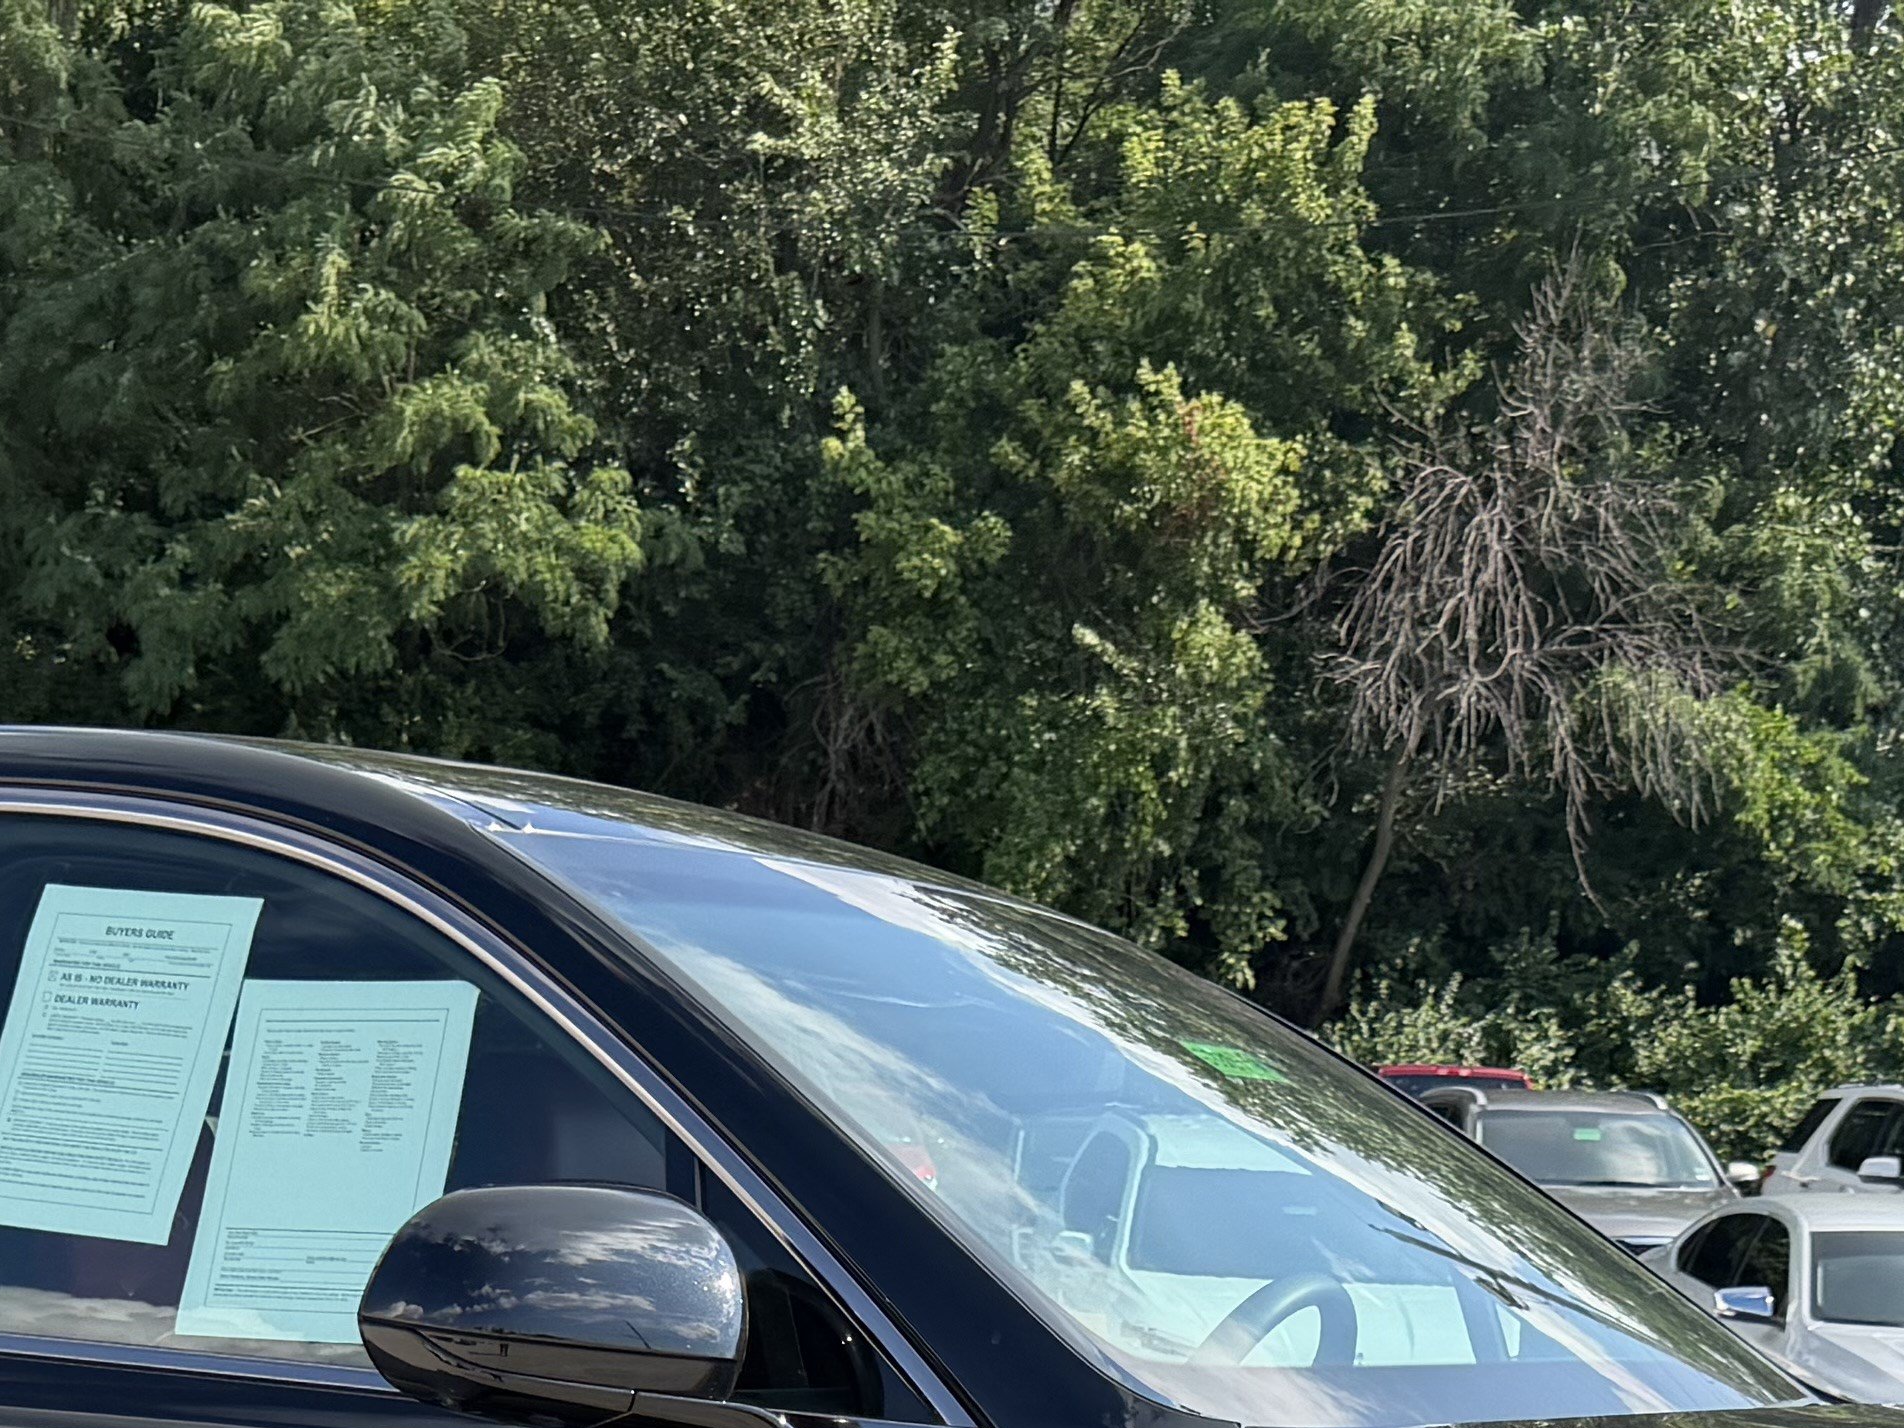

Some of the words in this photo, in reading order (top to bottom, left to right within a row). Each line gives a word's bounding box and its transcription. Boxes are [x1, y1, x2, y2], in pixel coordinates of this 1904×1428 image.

[105, 926, 144, 938] BUYERS
[145, 929, 175, 940] GUIDE
[89, 975, 101, 984] NO
[103, 976, 138, 987] DEALER
[139, 978, 190, 991] WARRANTY
[54, 993, 89, 1004] DEALER
[90, 996, 141, 1010] WARRANTY
